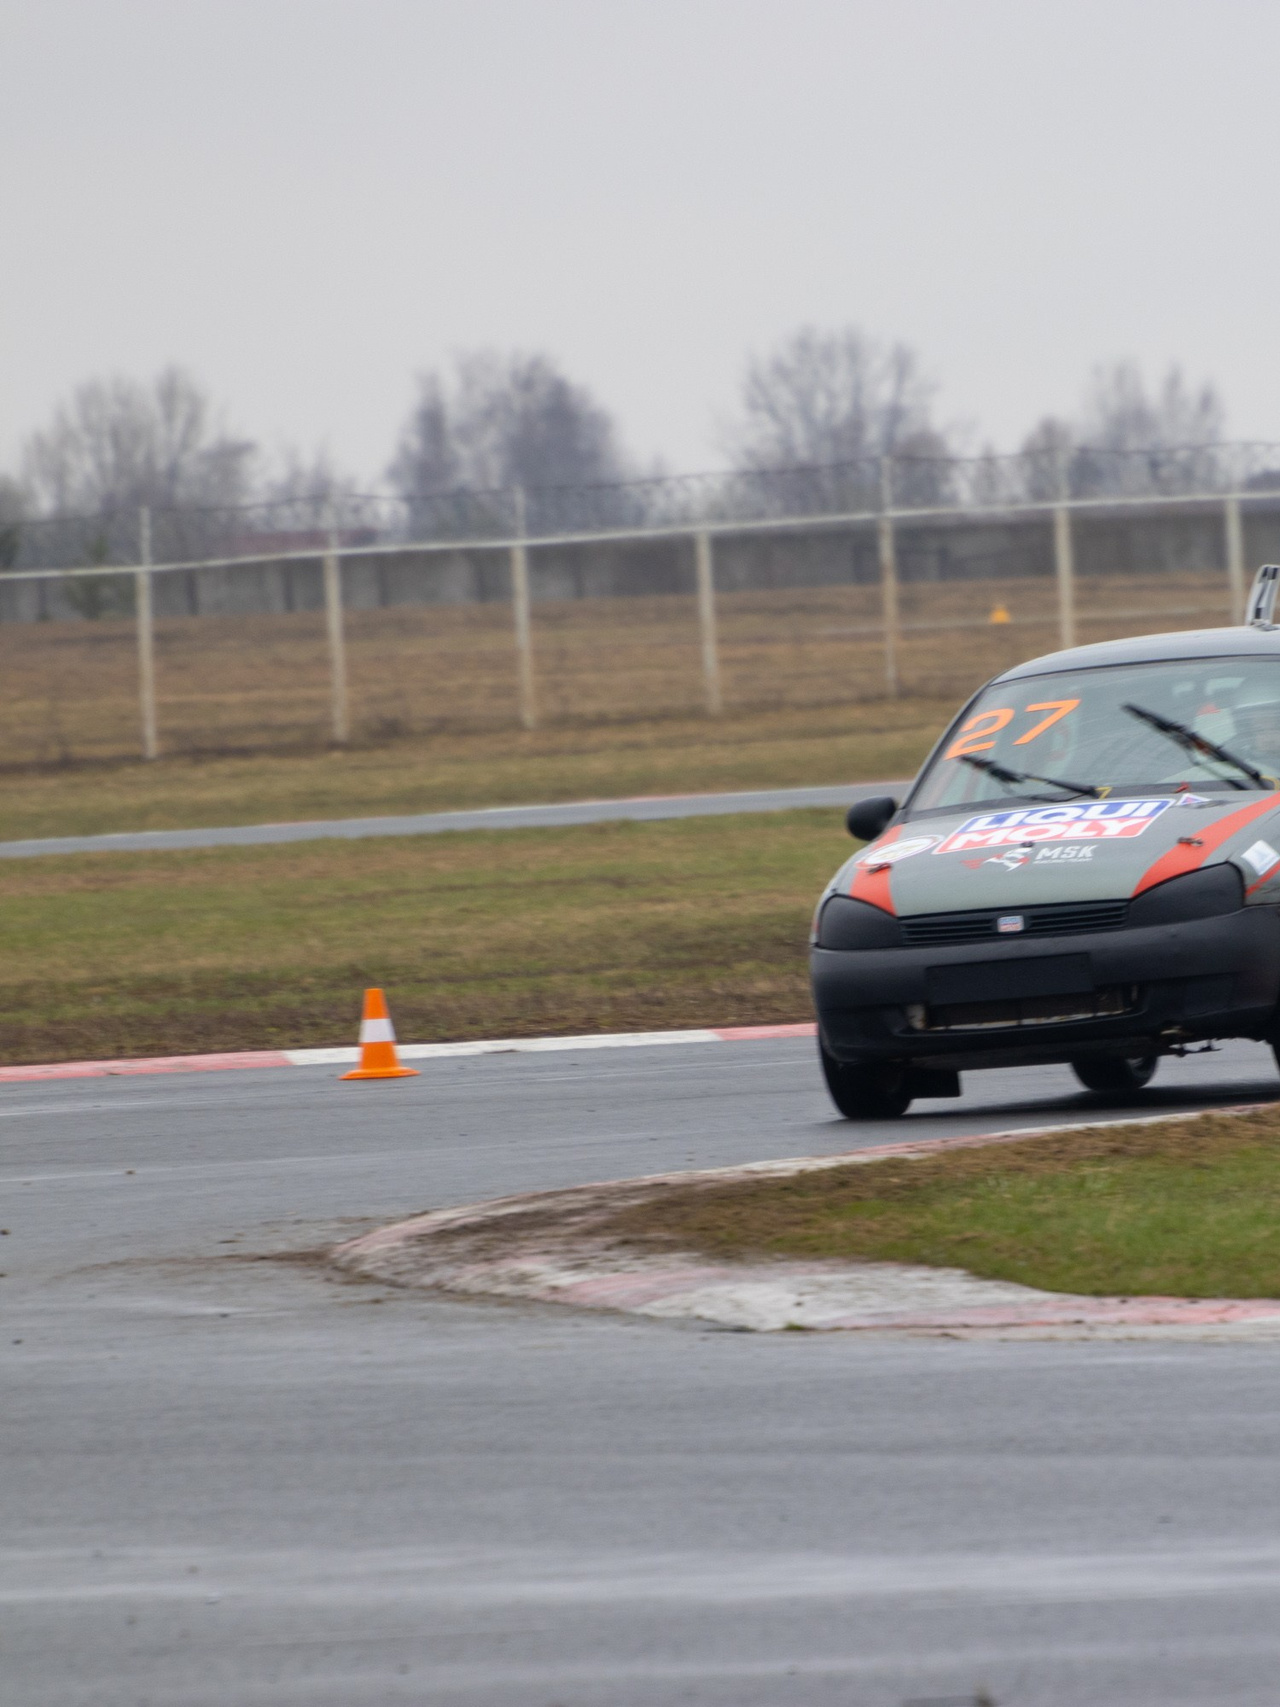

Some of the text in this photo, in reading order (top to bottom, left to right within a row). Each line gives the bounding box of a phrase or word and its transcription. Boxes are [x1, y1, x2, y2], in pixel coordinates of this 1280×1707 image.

[943, 699, 1082, 760] 27
[966, 801, 1164, 832] LIQUI
[950, 818, 1150, 850] MOLY
[1035, 845, 1099, 860] MSK
